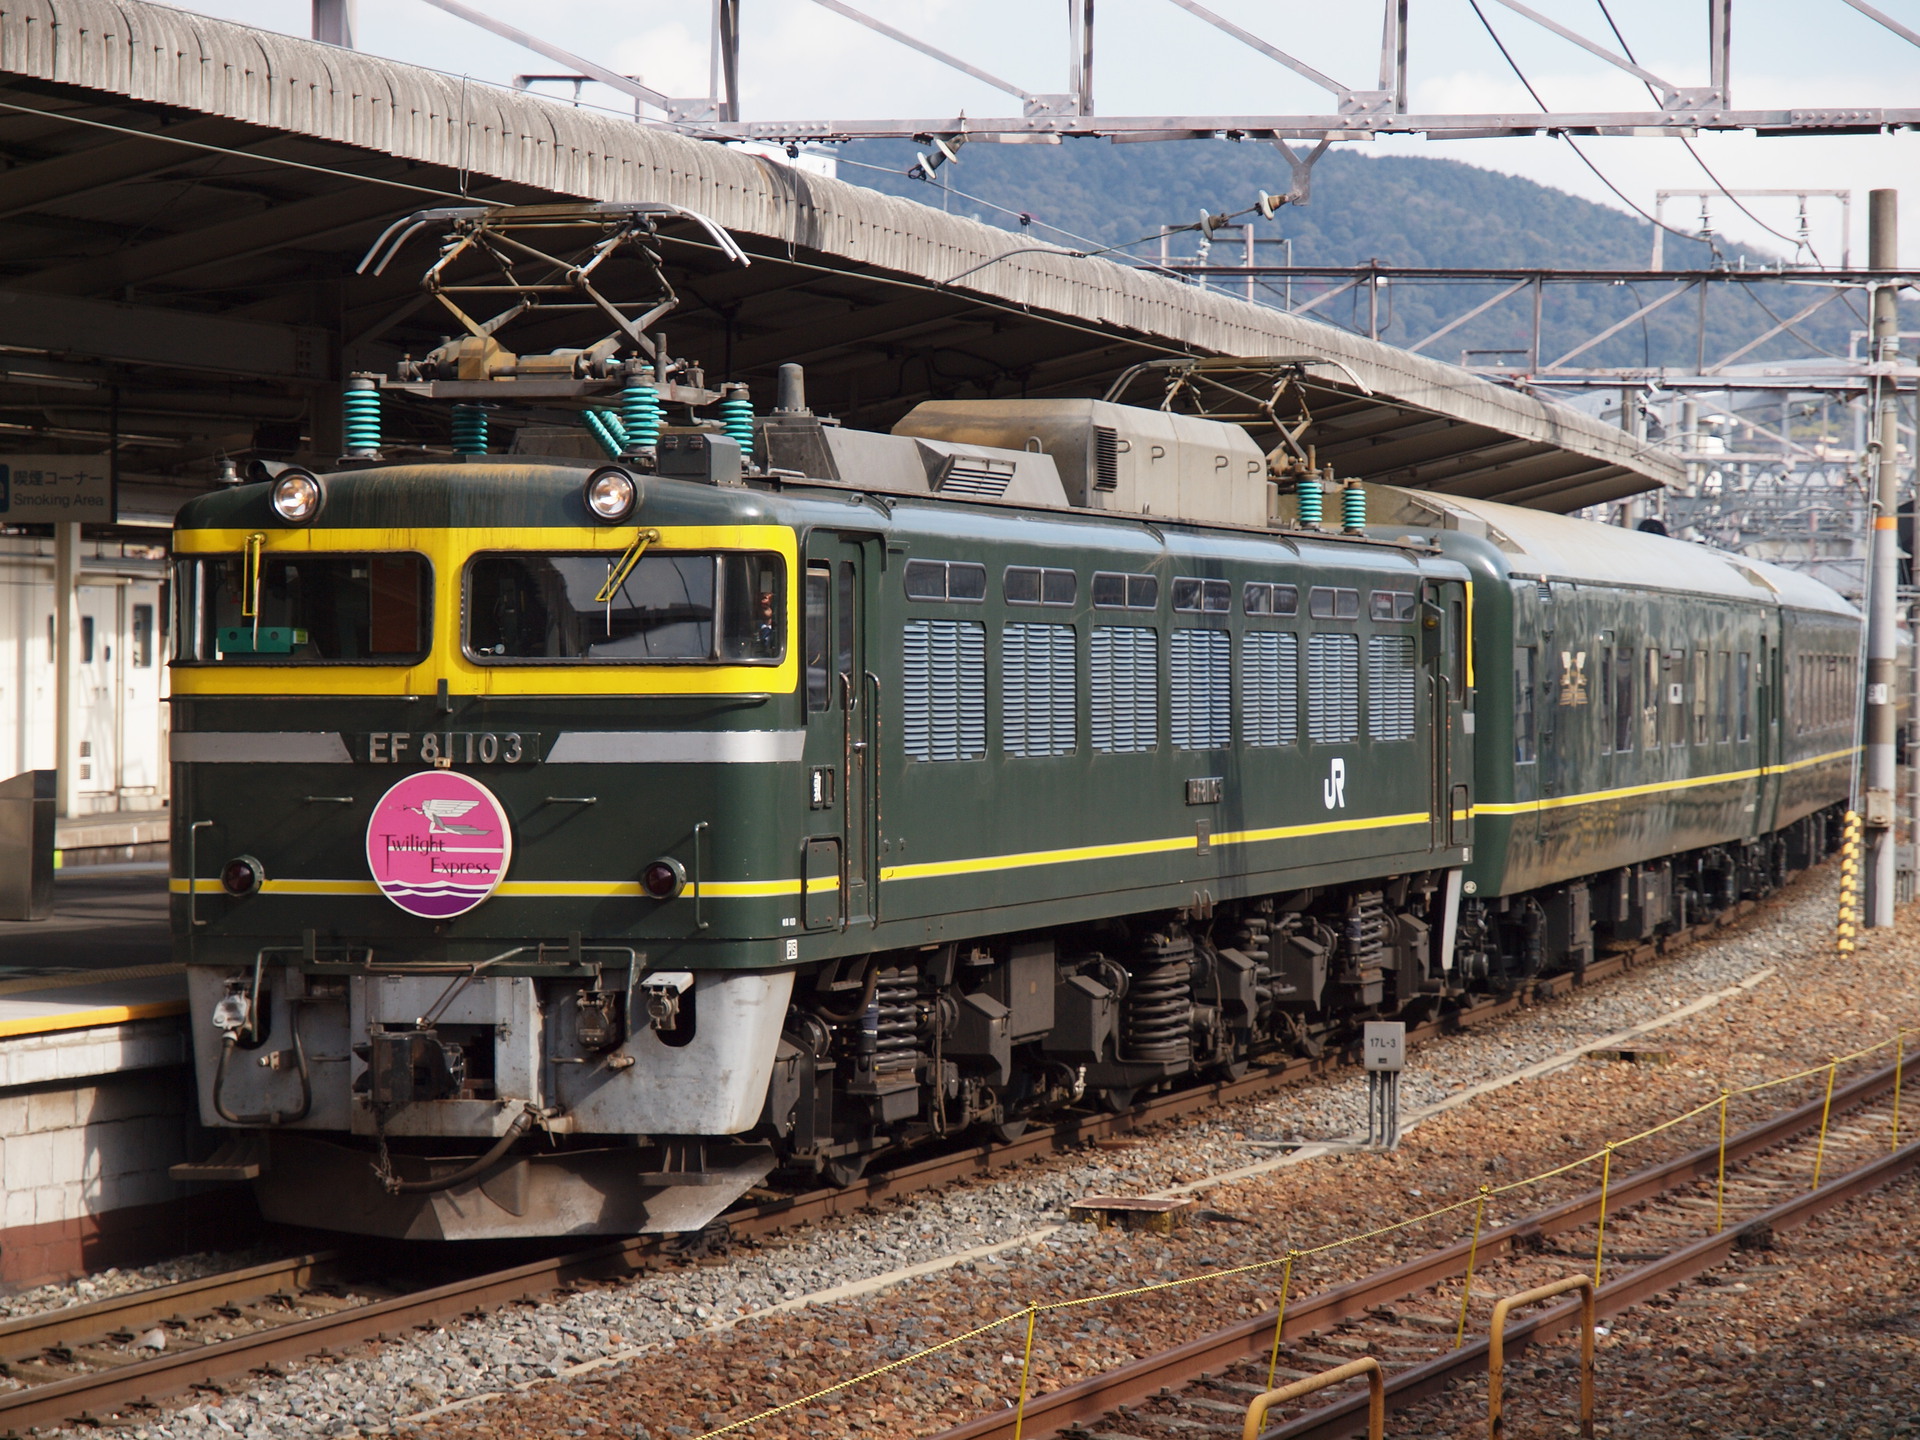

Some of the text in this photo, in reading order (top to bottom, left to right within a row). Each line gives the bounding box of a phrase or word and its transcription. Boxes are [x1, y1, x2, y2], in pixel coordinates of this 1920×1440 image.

[13, 470, 104, 486] 喫煙コーナー
[14, 493, 104, 508] Smoking Area
[369, 732, 522, 763] EF 81 103
[1324, 758, 1345, 809] JR
[379, 834, 446, 877] Twilight
[431, 857, 490, 877] Express
[1370, 1038, 1396, 1048] 17L-3
